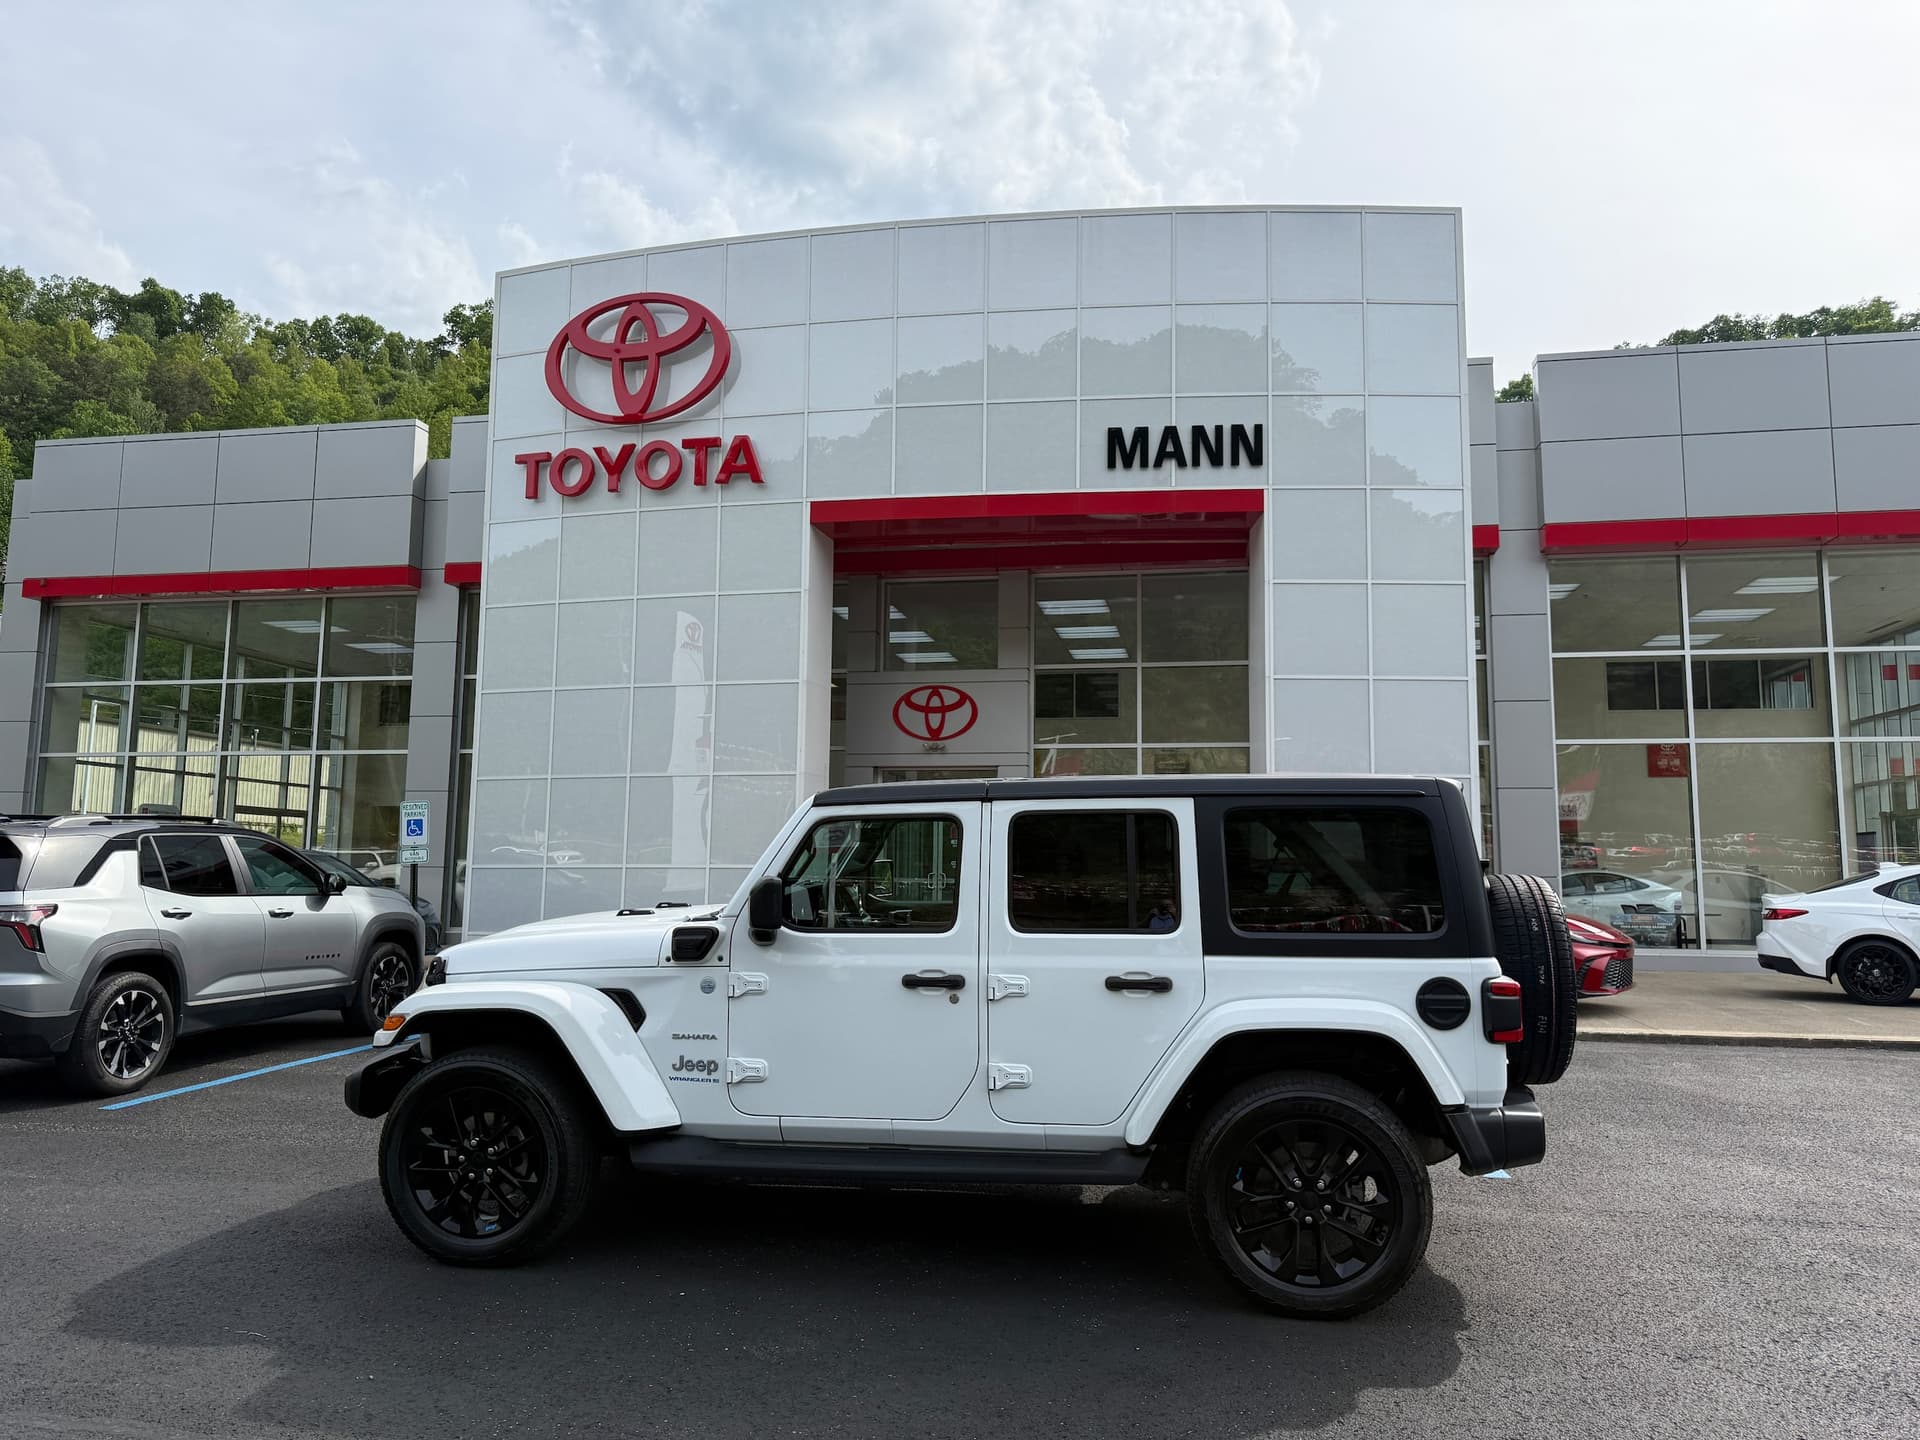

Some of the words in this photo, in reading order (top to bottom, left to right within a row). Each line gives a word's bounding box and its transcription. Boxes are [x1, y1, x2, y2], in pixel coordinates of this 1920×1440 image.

[515, 435, 764, 499] TOYOTA
[1107, 424, 1263, 469] MANN
[672, 1055, 719, 1076] Jeep
